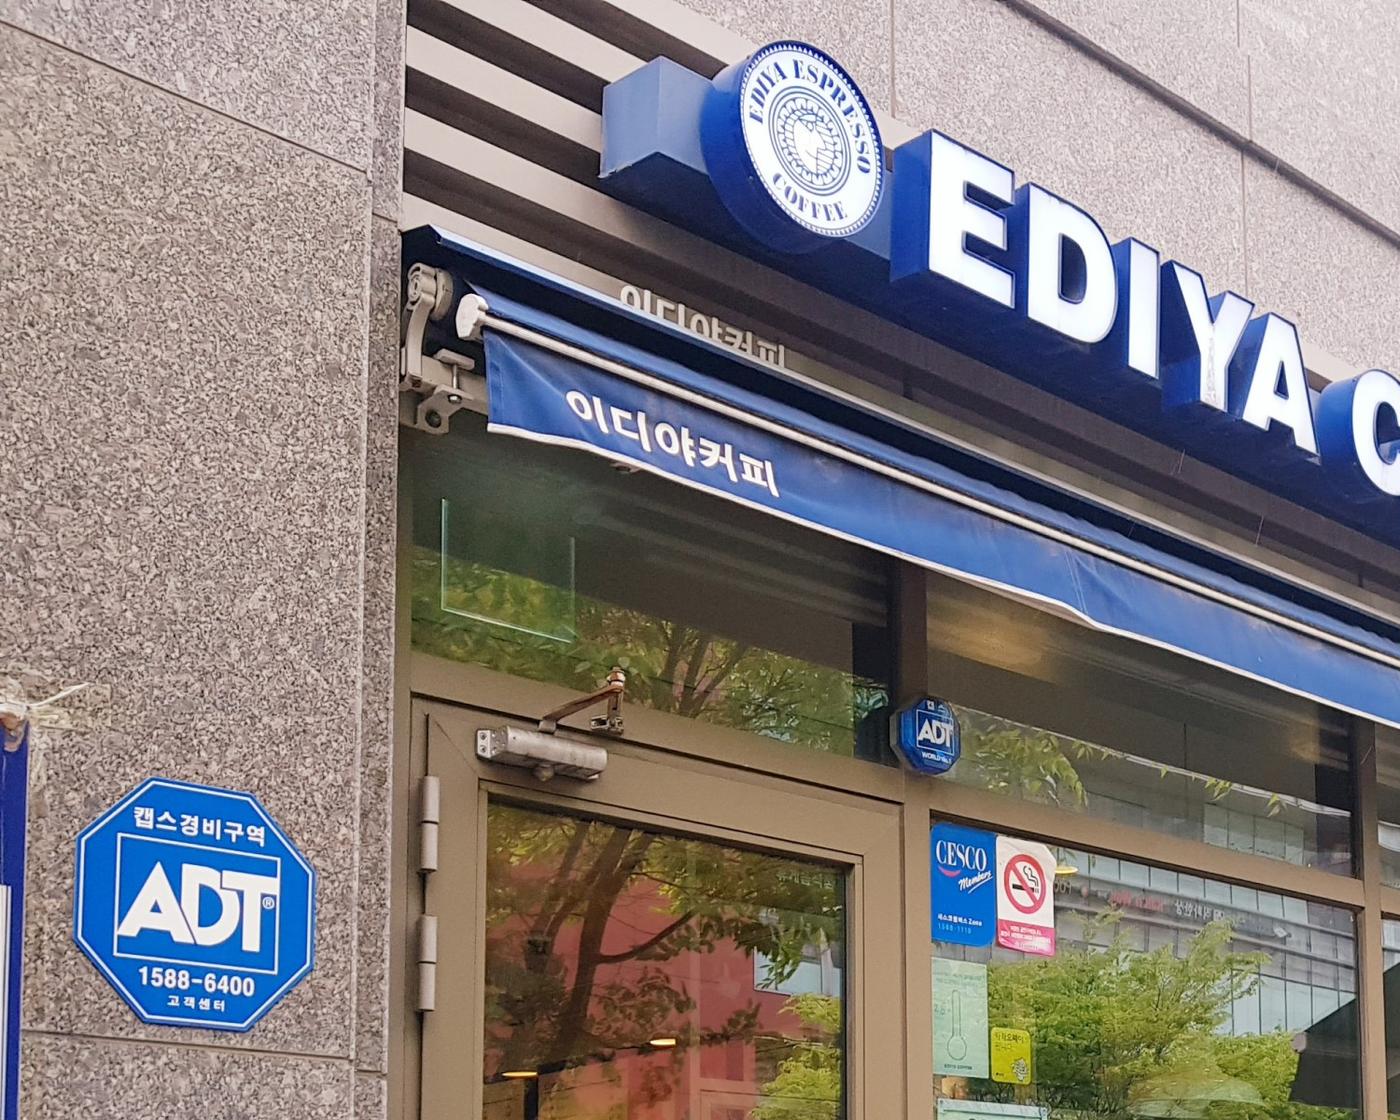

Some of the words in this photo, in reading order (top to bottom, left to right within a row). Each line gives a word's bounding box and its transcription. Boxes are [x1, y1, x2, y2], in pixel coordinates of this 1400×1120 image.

[749, 65, 788, 124] EDIYA
[793, 60, 870, 174] ESPRESSO
[772, 172, 848, 222] COFFEE
[929, 131, 1320, 458] EDIYA
[565, 390, 780, 498] 이디야커피
[918, 718, 953, 748] ADT
[134, 807, 265, 846] 캡스경비구역
[935, 840, 987, 871] CESCO
[117, 861, 280, 953] ADT
[138, 966, 255, 997] 1588-6400
[167, 995, 225, 1012] 고객센터
